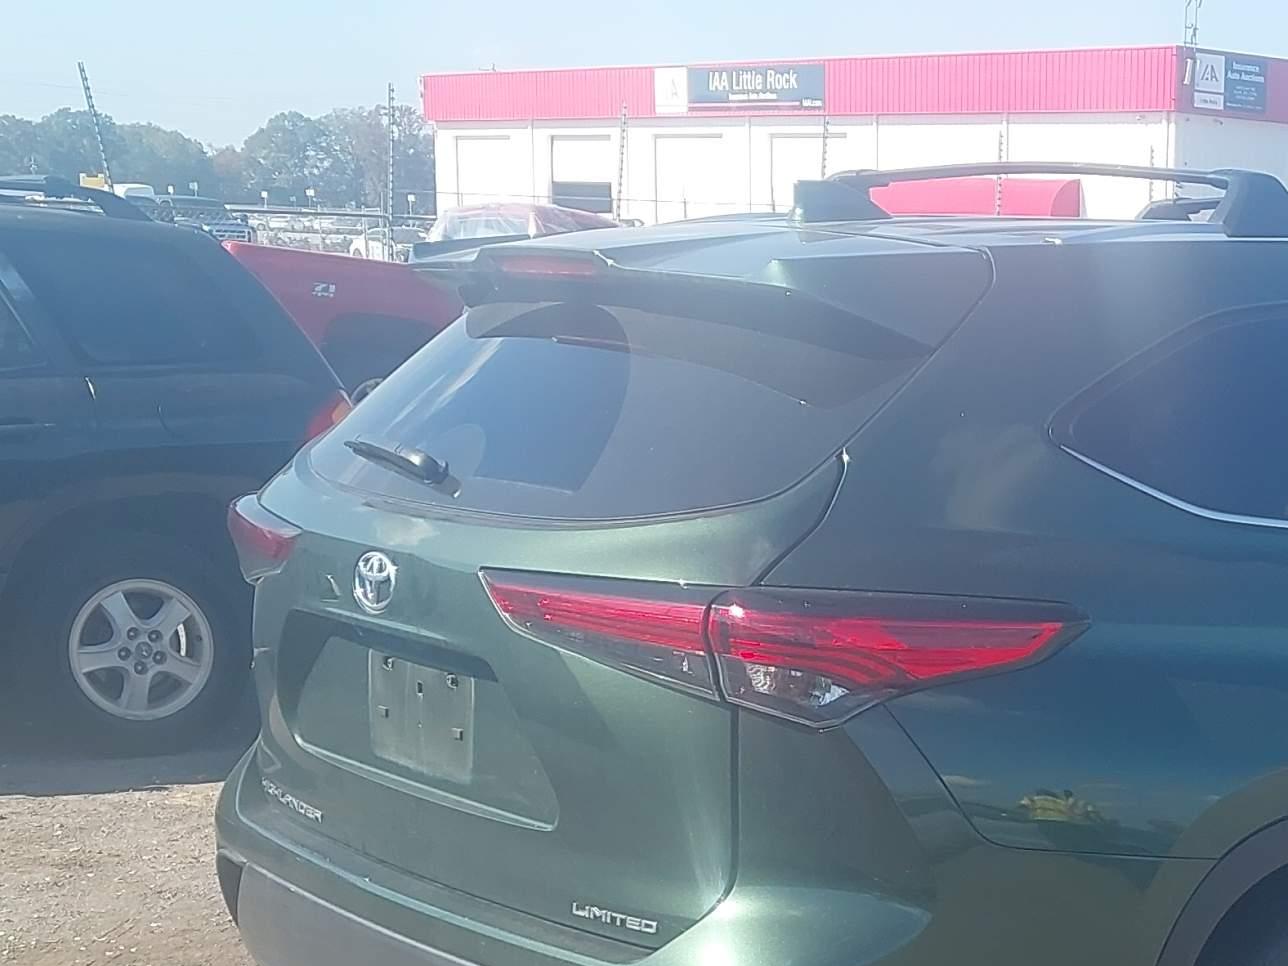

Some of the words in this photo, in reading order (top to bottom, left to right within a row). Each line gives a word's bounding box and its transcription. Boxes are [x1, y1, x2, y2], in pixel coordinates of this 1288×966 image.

[708, 71, 729, 91] IAA
[732, 68, 763, 91] Little
[766, 68, 798, 90] Rock
[572, 902, 658, 934] LIMITED
